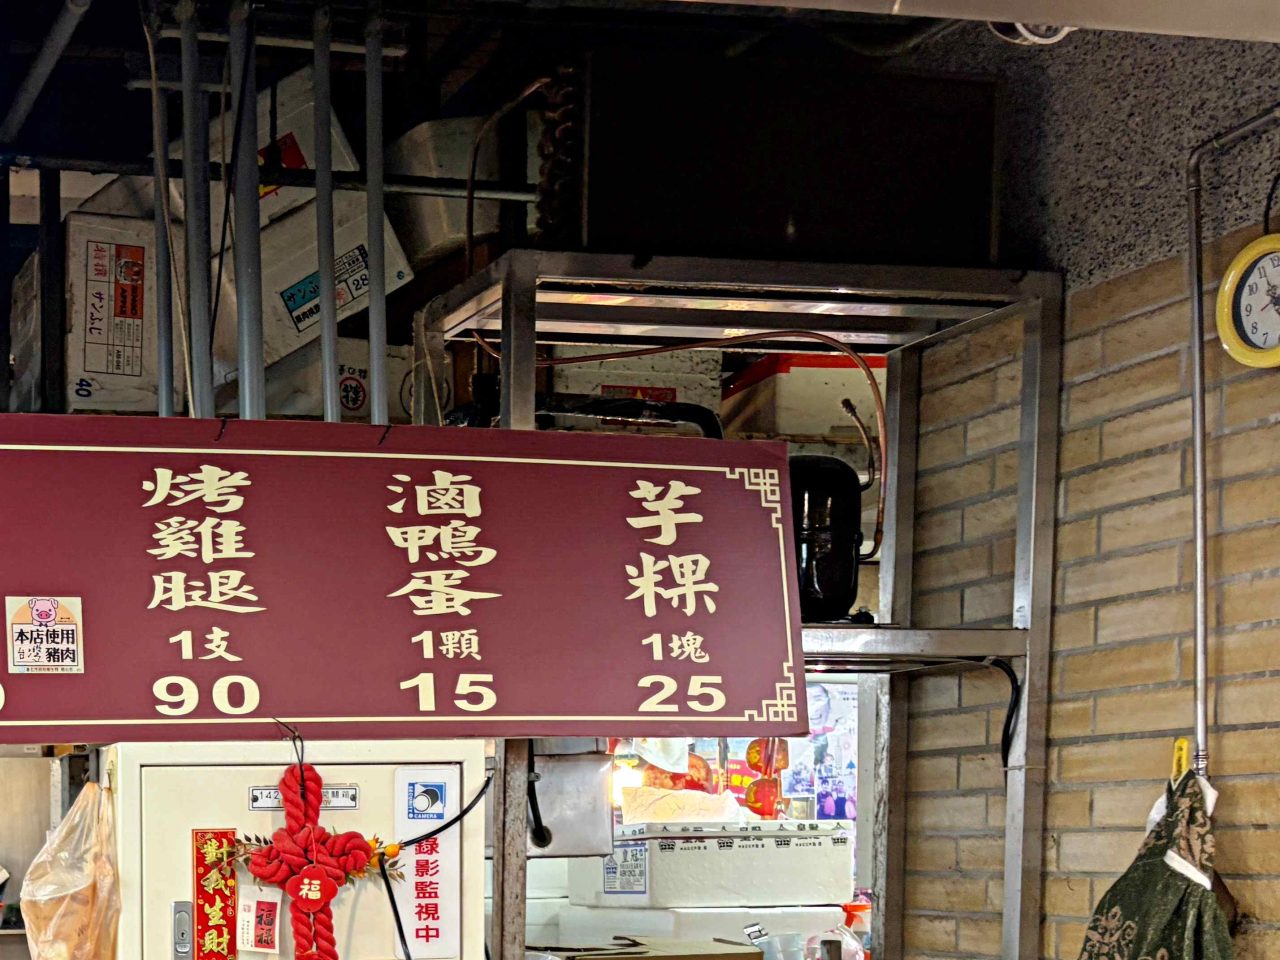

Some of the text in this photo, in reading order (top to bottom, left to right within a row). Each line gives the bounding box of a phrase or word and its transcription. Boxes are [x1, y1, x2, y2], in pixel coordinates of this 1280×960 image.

[1248, 282, 1258, 296] 10
[1245, 304, 1252, 316] 9
[1251, 322, 1258, 335] 8
[1262, 332, 1269, 345] 7
[75, 378, 92, 398] 40
[142, 464, 267, 613] 烤雞腿
[386, 470, 503, 616] 滷鴨蛋
[625, 479, 719, 617] 芋粿
[15, 629, 75, 645] 本店使用
[169, 627, 243, 662] 1支
[411, 629, 482, 662] 1顆
[641, 633, 711, 663] 1塊
[152, 675, 261, 715] 90
[399, 673, 497, 712] 15
[637, 675, 726, 712] 25
[201, 838, 231, 957] 對我生財
[299, 878, 321, 900] 福
[415, 836, 440, 943] 錄影監視中
